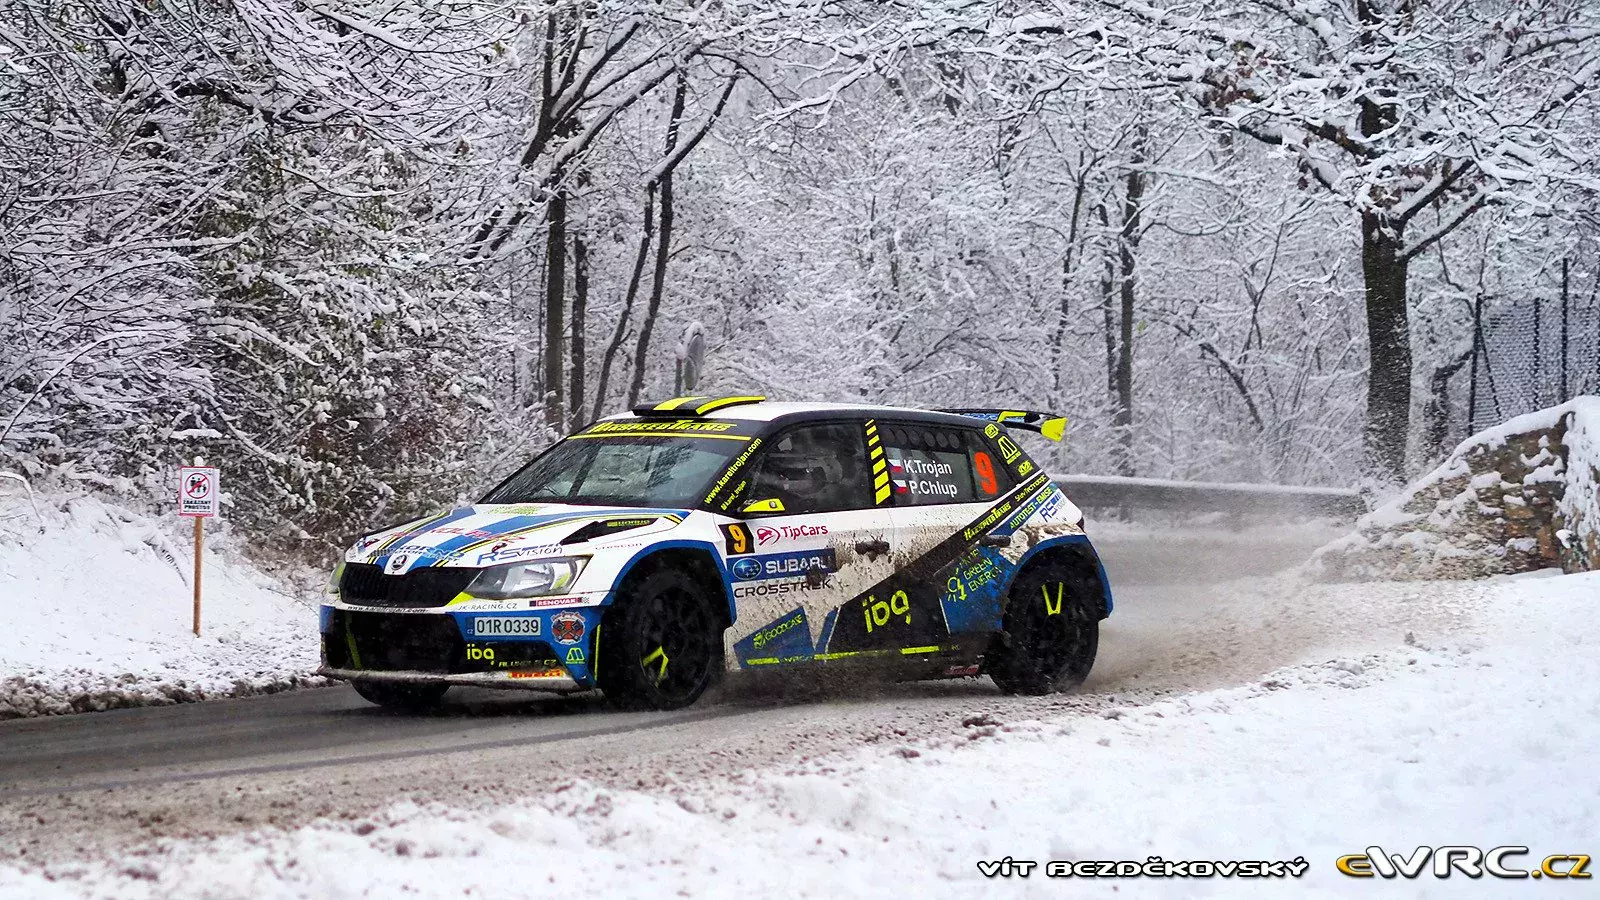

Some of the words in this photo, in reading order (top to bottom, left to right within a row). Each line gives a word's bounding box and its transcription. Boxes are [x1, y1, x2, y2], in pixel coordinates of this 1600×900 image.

[704, 437, 762, 505] www.kareltrojan.com
[903, 459, 952, 477] K.Trojan
[974, 451, 998, 495] 9
[909, 481, 958, 497] P.Chlup
[728, 524, 746, 553] 9
[781, 525, 829, 540] TipCars
[964, 557, 993, 580] GREEN
[477, 619, 501, 633] 01R
[504, 619, 539, 633] 0339
